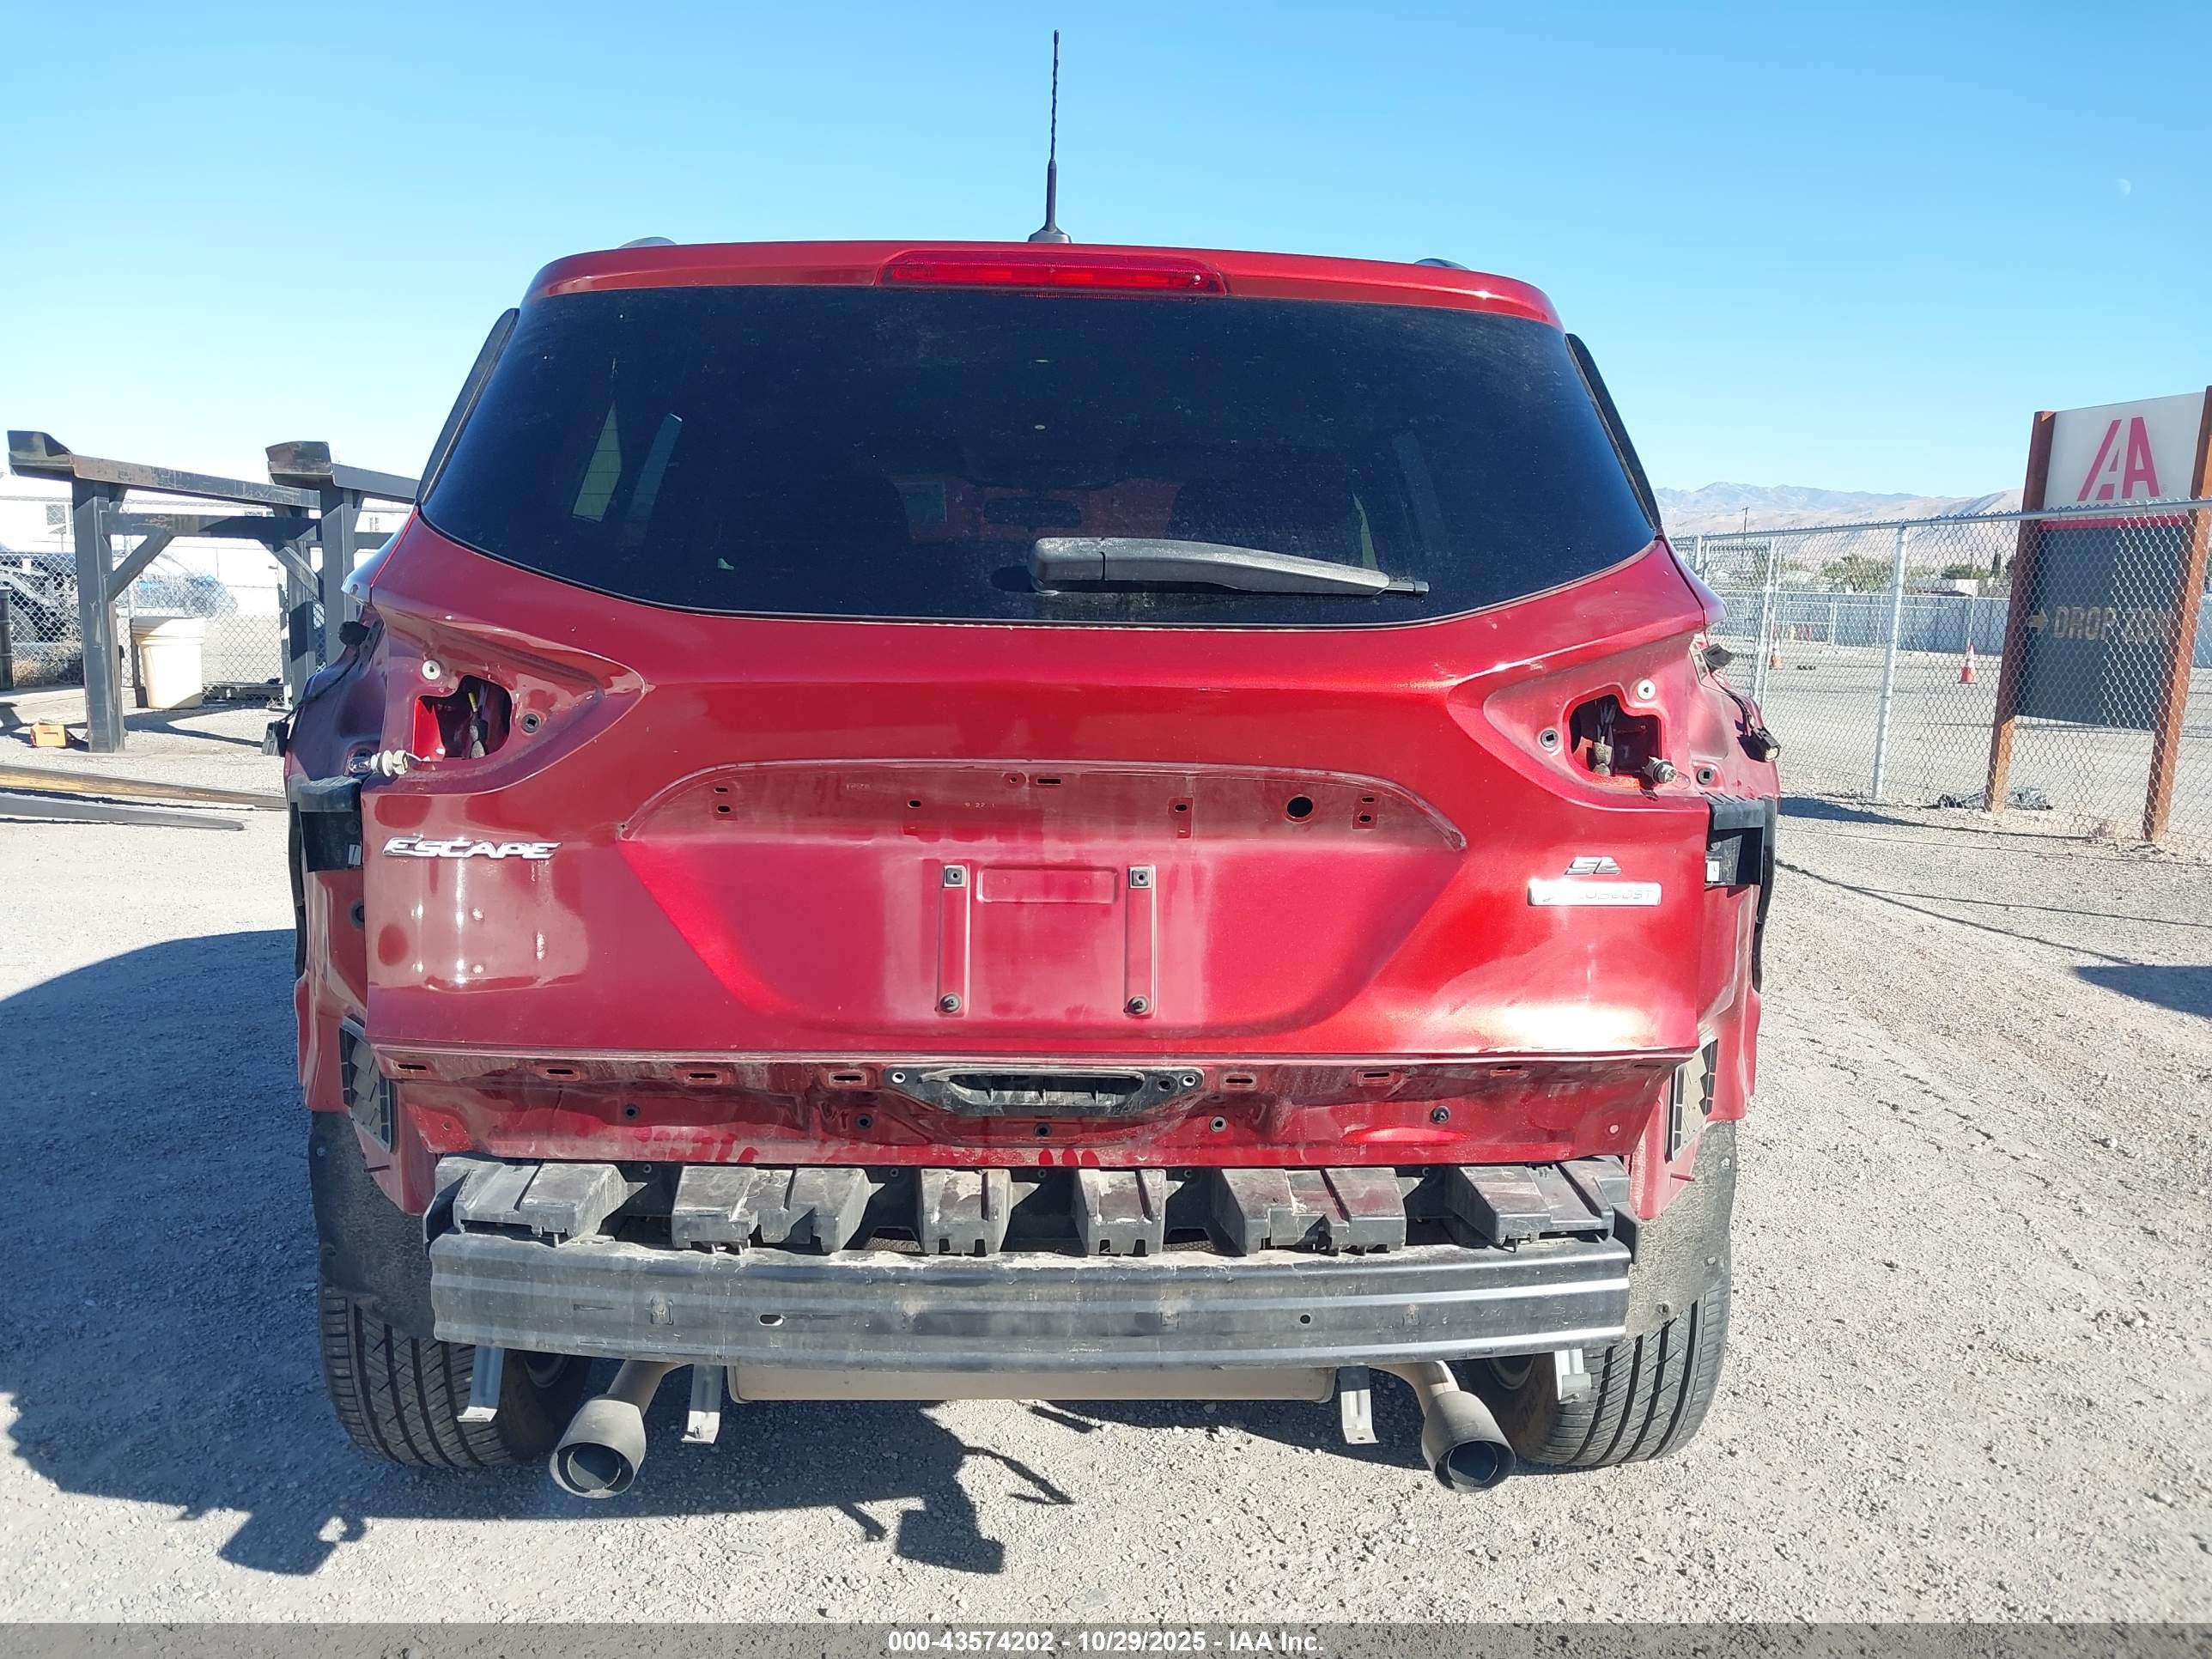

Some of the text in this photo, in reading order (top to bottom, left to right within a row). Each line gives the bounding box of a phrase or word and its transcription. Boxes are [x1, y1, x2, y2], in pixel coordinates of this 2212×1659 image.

[2053, 606, 2173, 644] DROP ZON
[383, 836, 562, 859] ESCAPE
